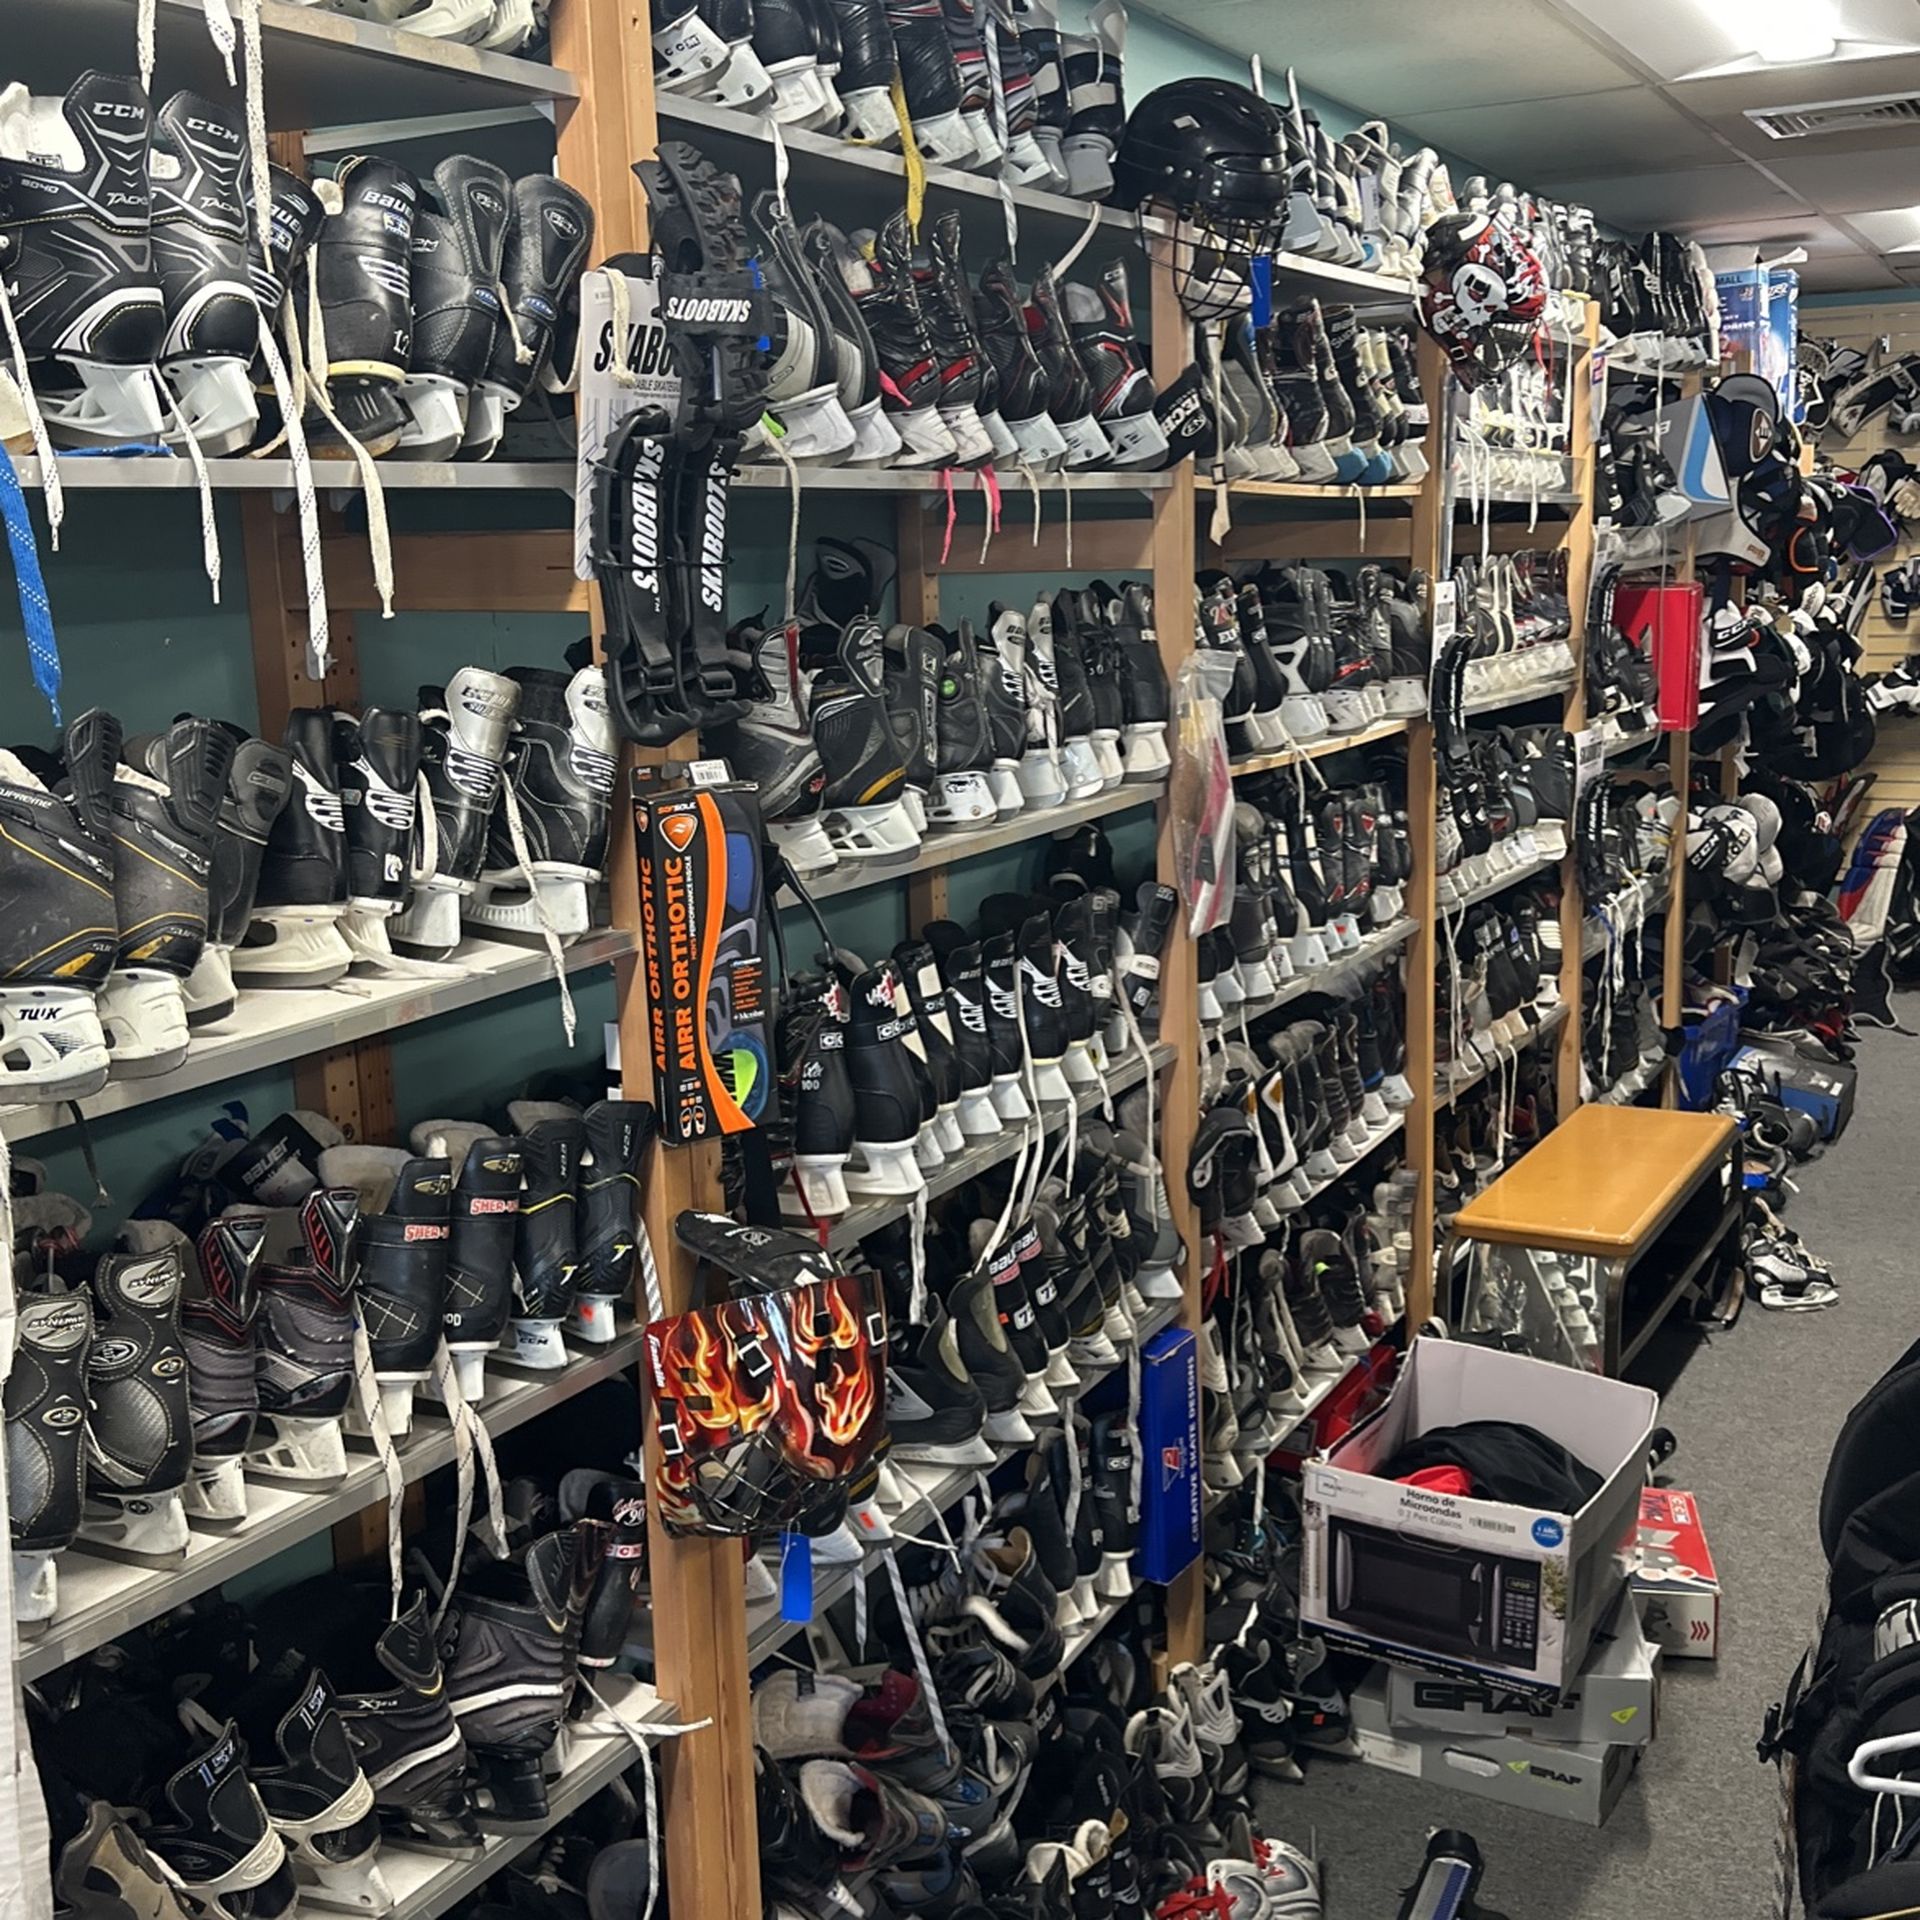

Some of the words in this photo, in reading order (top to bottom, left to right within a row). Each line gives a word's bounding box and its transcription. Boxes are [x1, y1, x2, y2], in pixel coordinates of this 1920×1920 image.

[665, 35, 701, 57] CCM
[93, 102, 145, 120] CCM
[186, 117, 239, 143] CCM
[361, 190, 415, 222] Baue
[1716, 276, 1742, 285] MALL
[667, 297, 752, 323] SKABOOTS
[632, 438, 664, 594] SKABOOTS
[700, 461, 728, 613] SKABOOTS
[640, 857, 662, 1000] ORTHOTIC
[664, 856, 691, 1000] ORTHOTIC
[685, 883, 697, 937] PERFORMANCE
[652, 1007, 667, 1073] AIRR
[676, 1006, 697, 1071] AIRR
[519, 1336, 549, 1346] CCM
[646, 1333, 666, 1389] Franklin
[1186, 1355, 1197, 1419] DESIGNS
[1188, 1422, 1198, 1469] SKATE
[1189, 1473, 1200, 1543] CREATIVE
[1400, 1497, 1462, 1519] Microondas
[1406, 1488, 1439, 1505] Horno
[1441, 1497, 1456, 1508] de
[1530, 1764, 1583, 1785] GRAF
